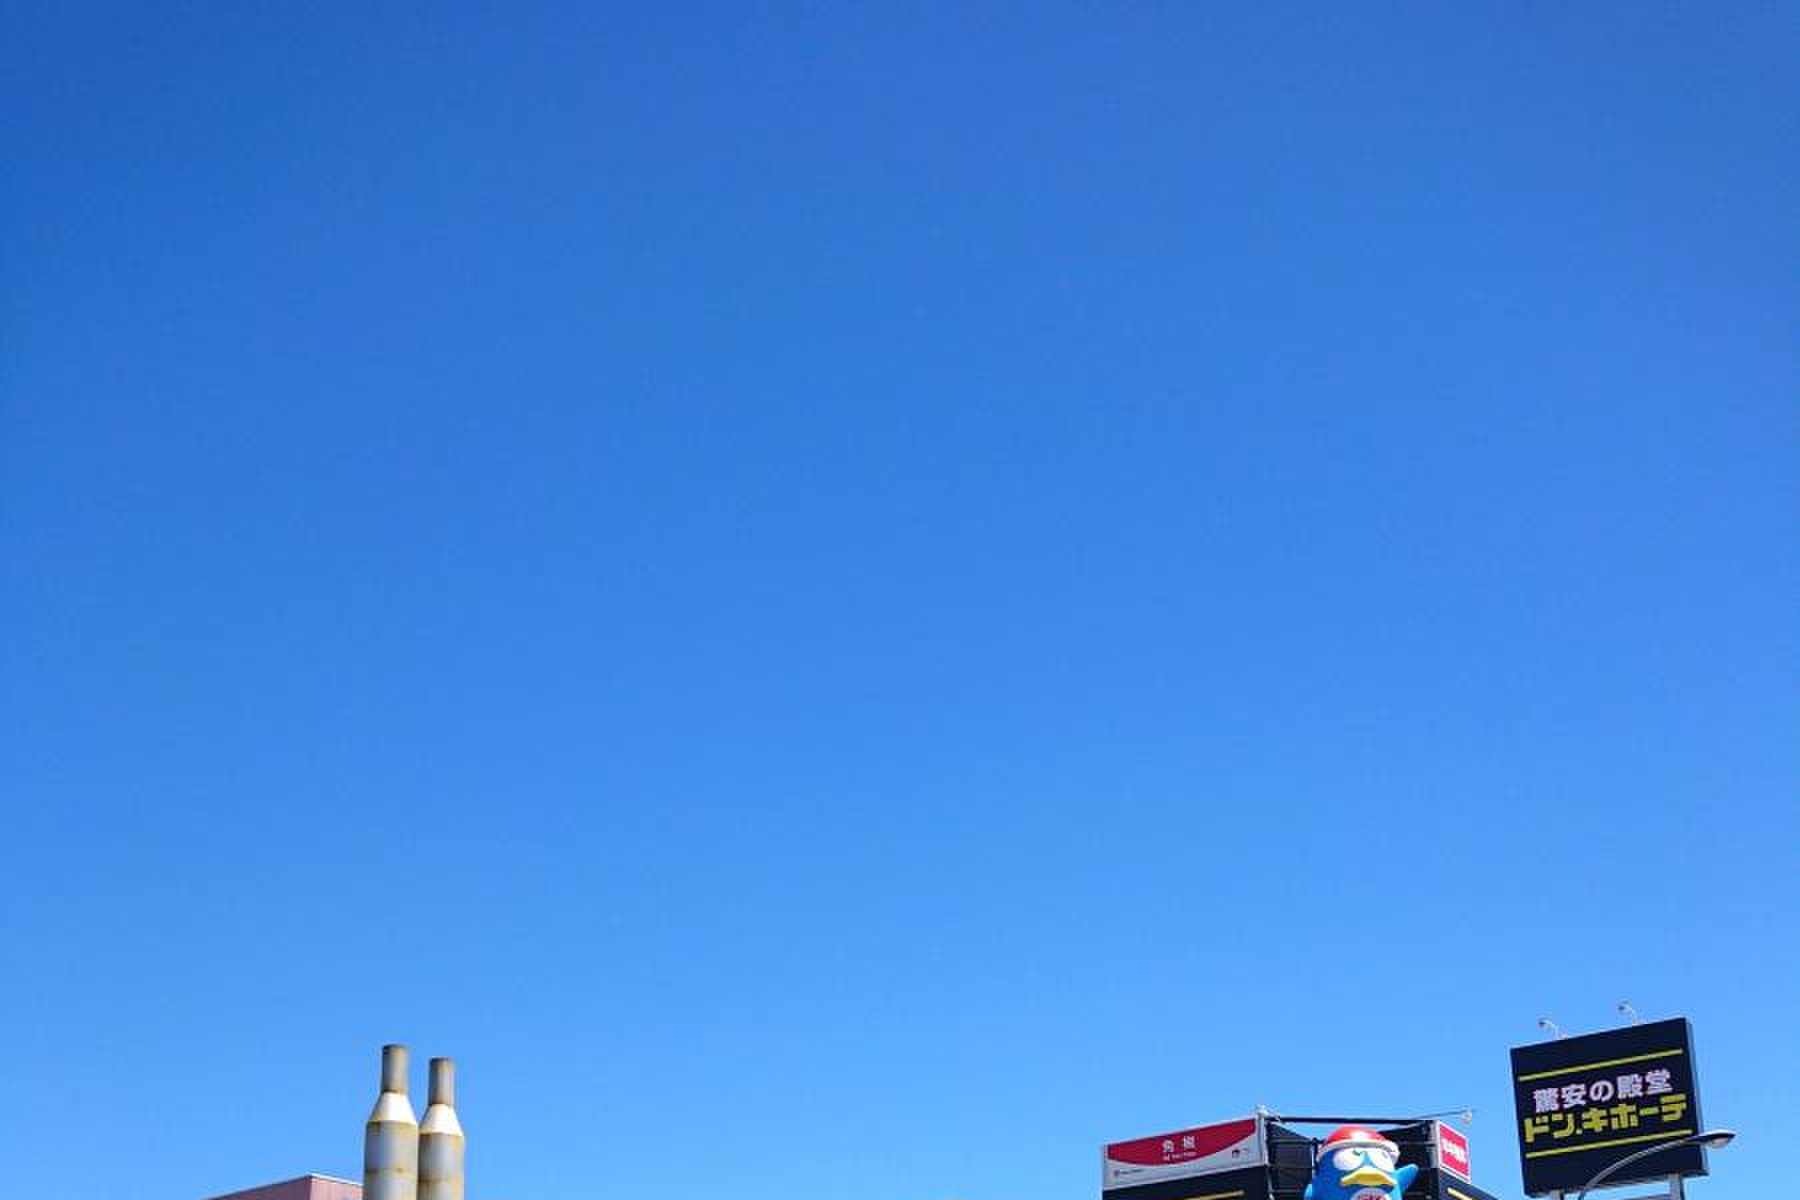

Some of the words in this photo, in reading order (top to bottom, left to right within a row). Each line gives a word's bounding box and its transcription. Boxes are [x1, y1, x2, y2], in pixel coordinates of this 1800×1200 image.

[1533, 1068, 1674, 1114] 驚安の殿堂
